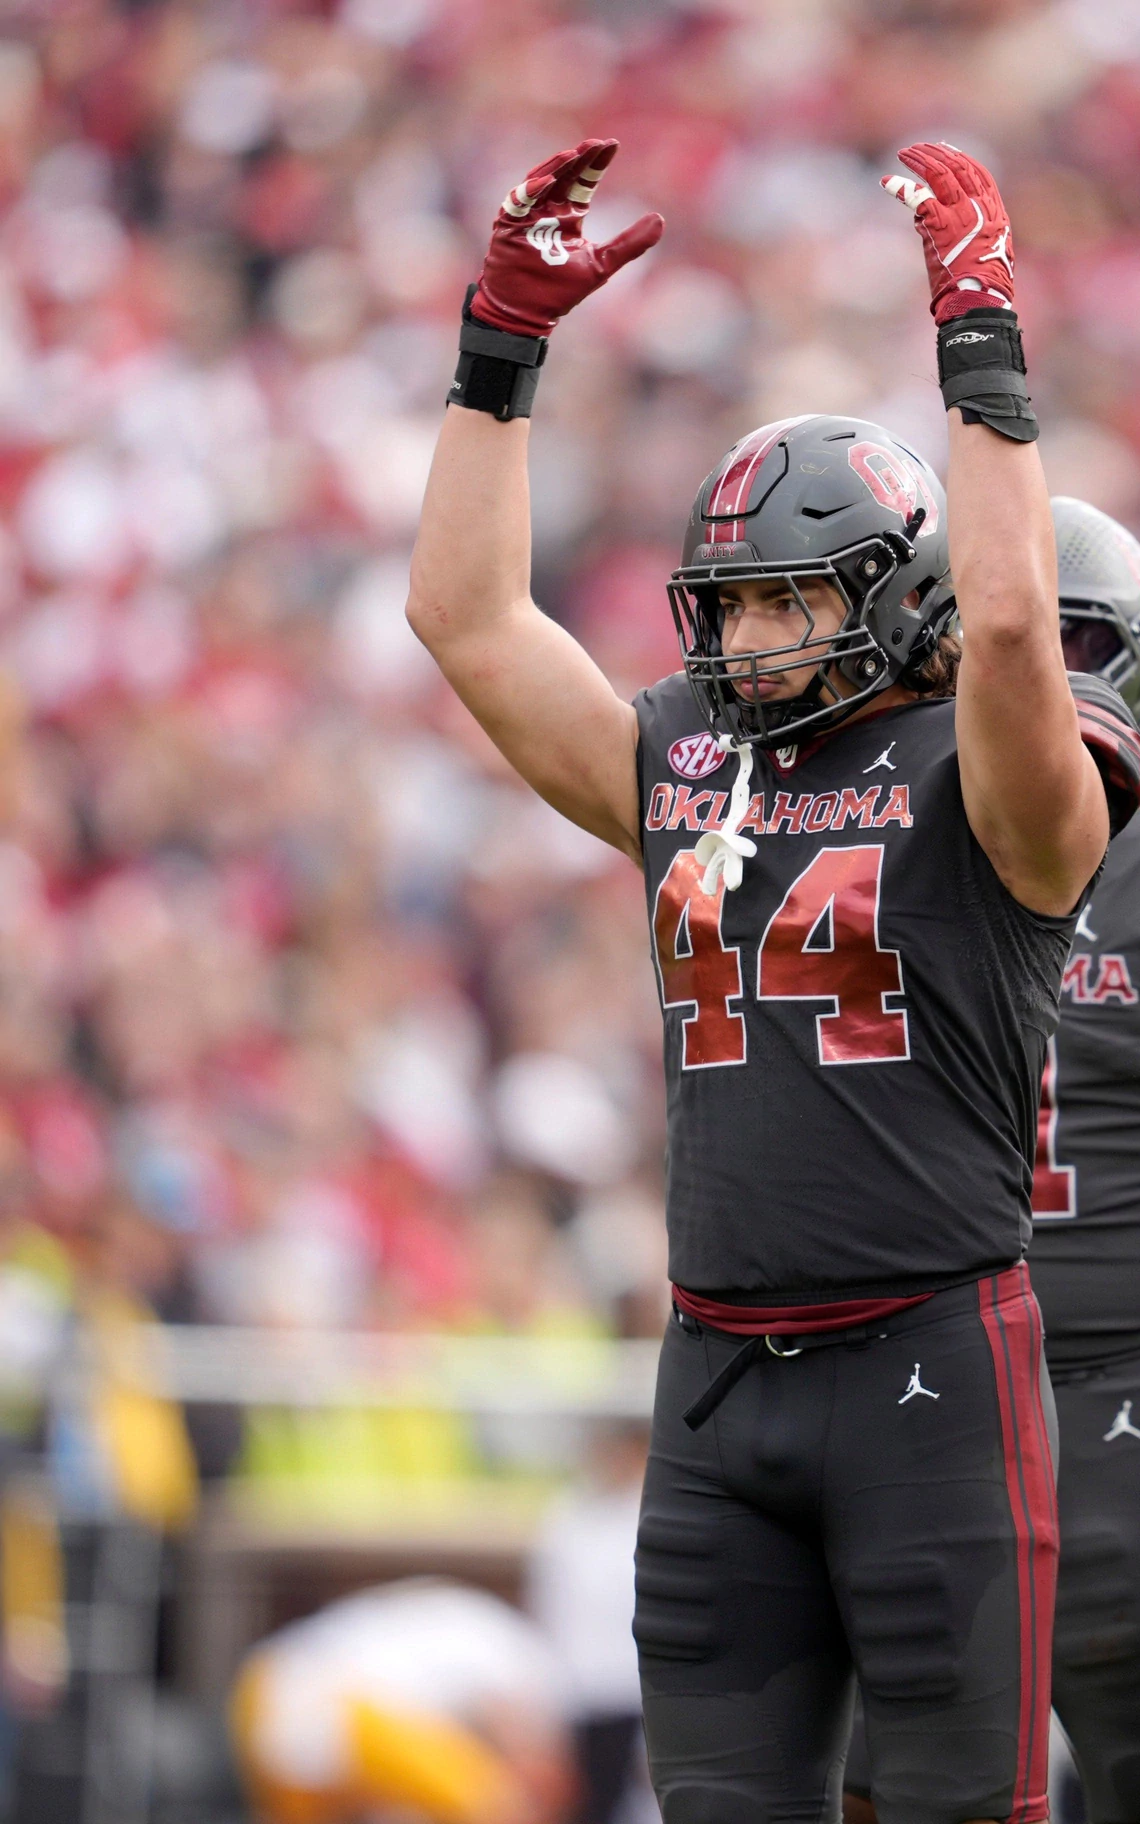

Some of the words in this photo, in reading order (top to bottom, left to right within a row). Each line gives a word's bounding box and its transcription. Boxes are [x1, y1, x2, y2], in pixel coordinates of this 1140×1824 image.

[526, 217, 570, 266] OU
[848, 441, 938, 538] OU
[702, 545, 736, 559] UNITY
[673, 732, 725, 776] SEC
[645, 783, 913, 834] OKLAHOMA
[653, 844, 911, 1070] 44
